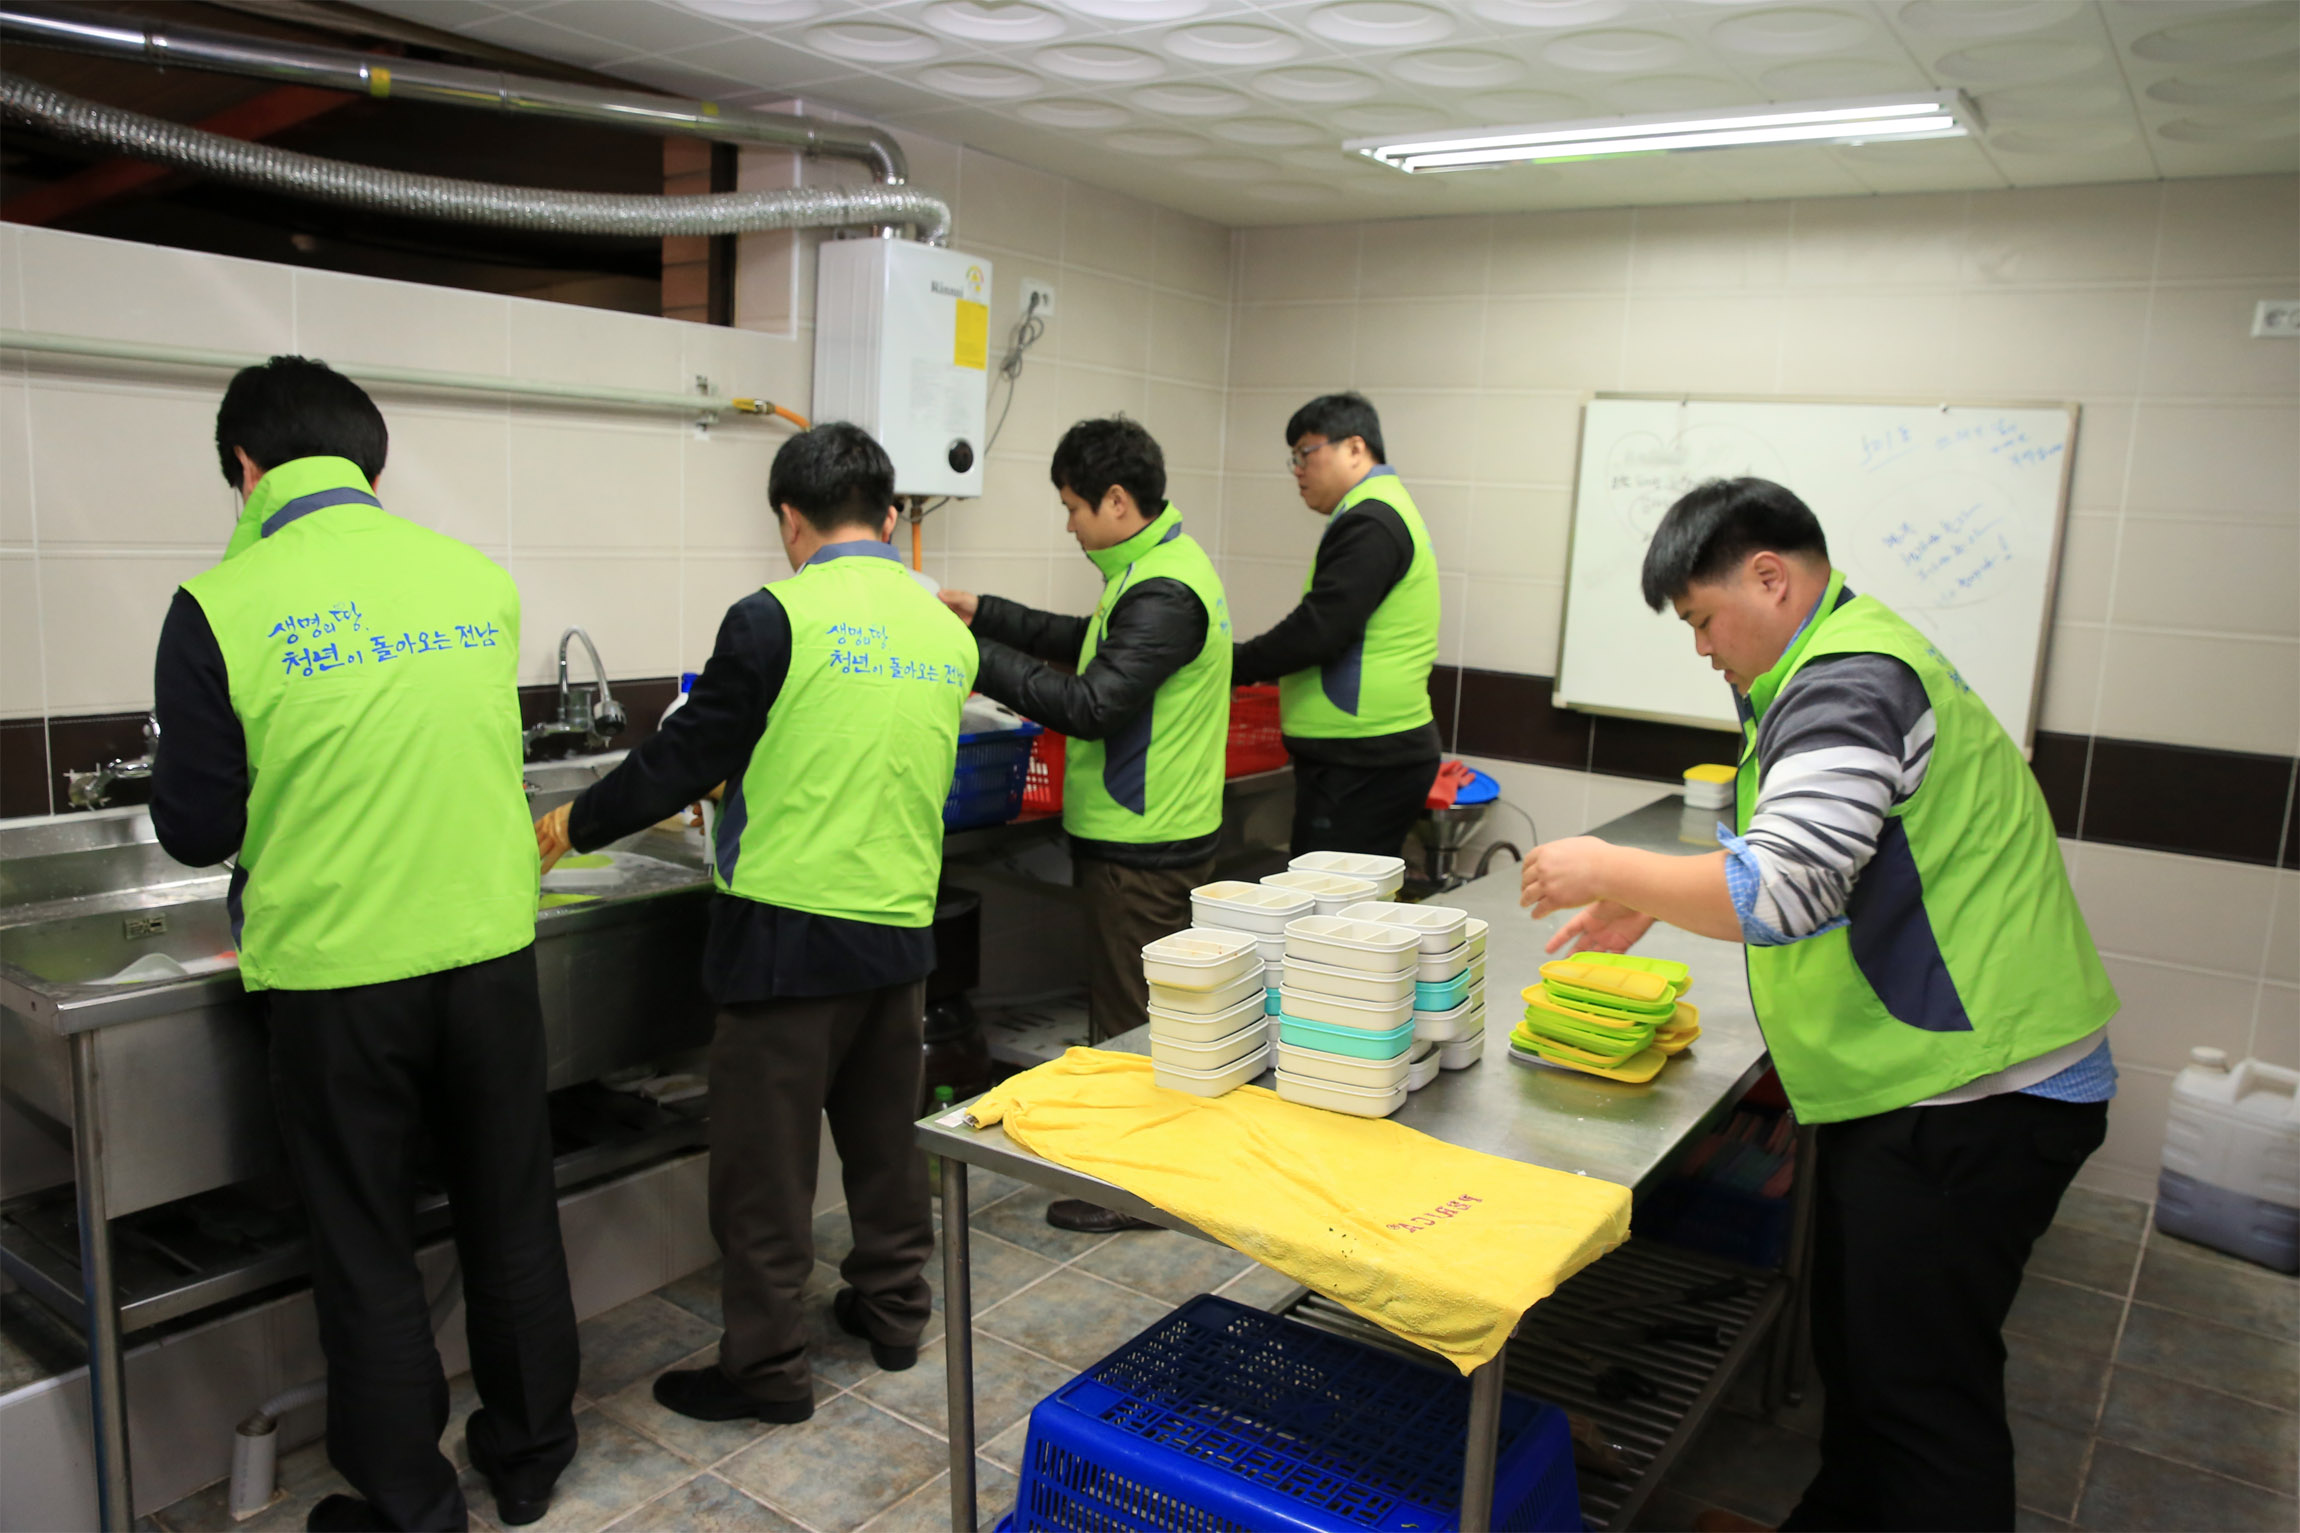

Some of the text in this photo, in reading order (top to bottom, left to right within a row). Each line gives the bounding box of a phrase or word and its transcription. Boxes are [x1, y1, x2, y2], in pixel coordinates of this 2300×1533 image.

[281, 621, 500, 678] 청년이 돌아오는 전남
[829, 649, 884, 675] 청년이
[889, 656, 940, 682] 돌아오는
